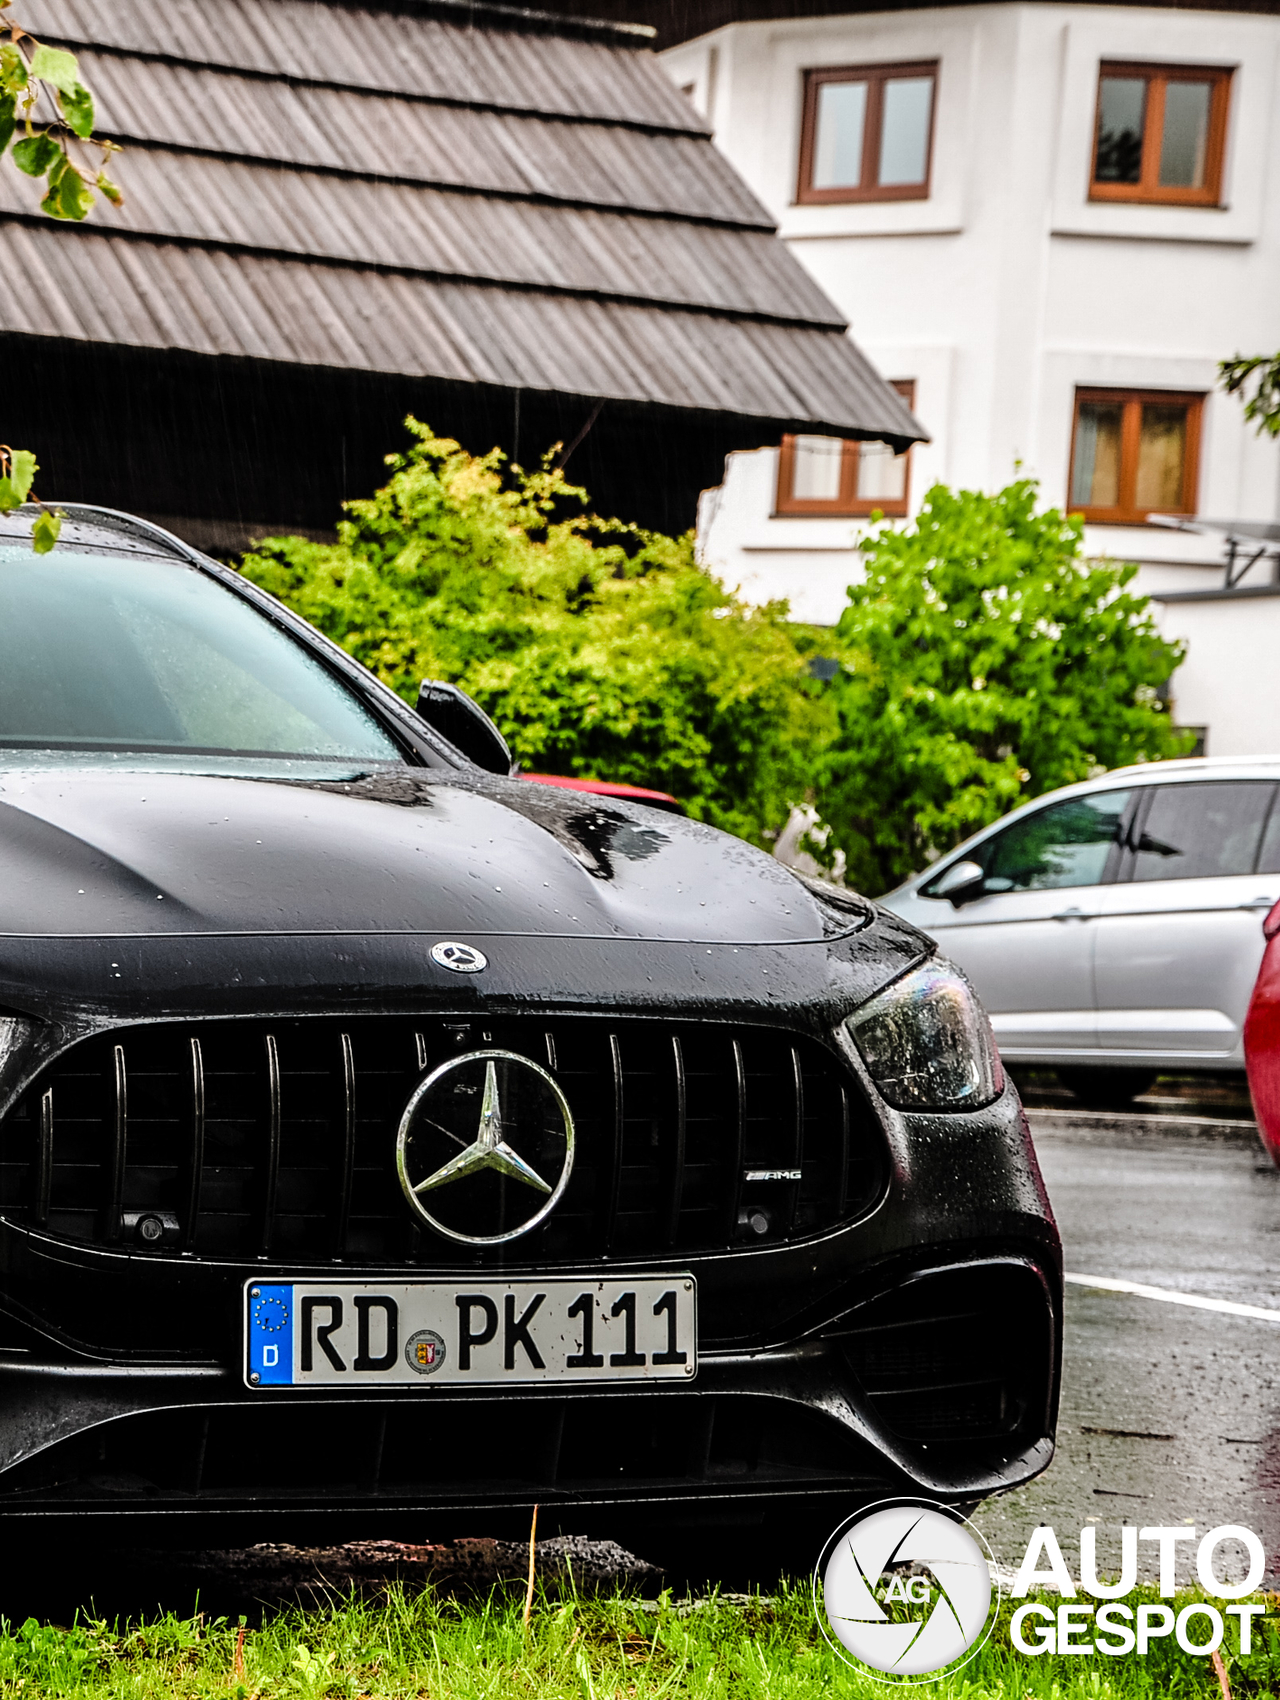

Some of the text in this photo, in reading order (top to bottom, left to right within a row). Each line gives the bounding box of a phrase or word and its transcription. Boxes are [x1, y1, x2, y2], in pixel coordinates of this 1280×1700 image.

[765, 1171, 802, 1180] AMG
[300, 1295, 400, 1372] RD
[455, 1293, 547, 1371] PK
[566, 1290, 688, 1369] 111
[262, 1344, 280, 1367] D
